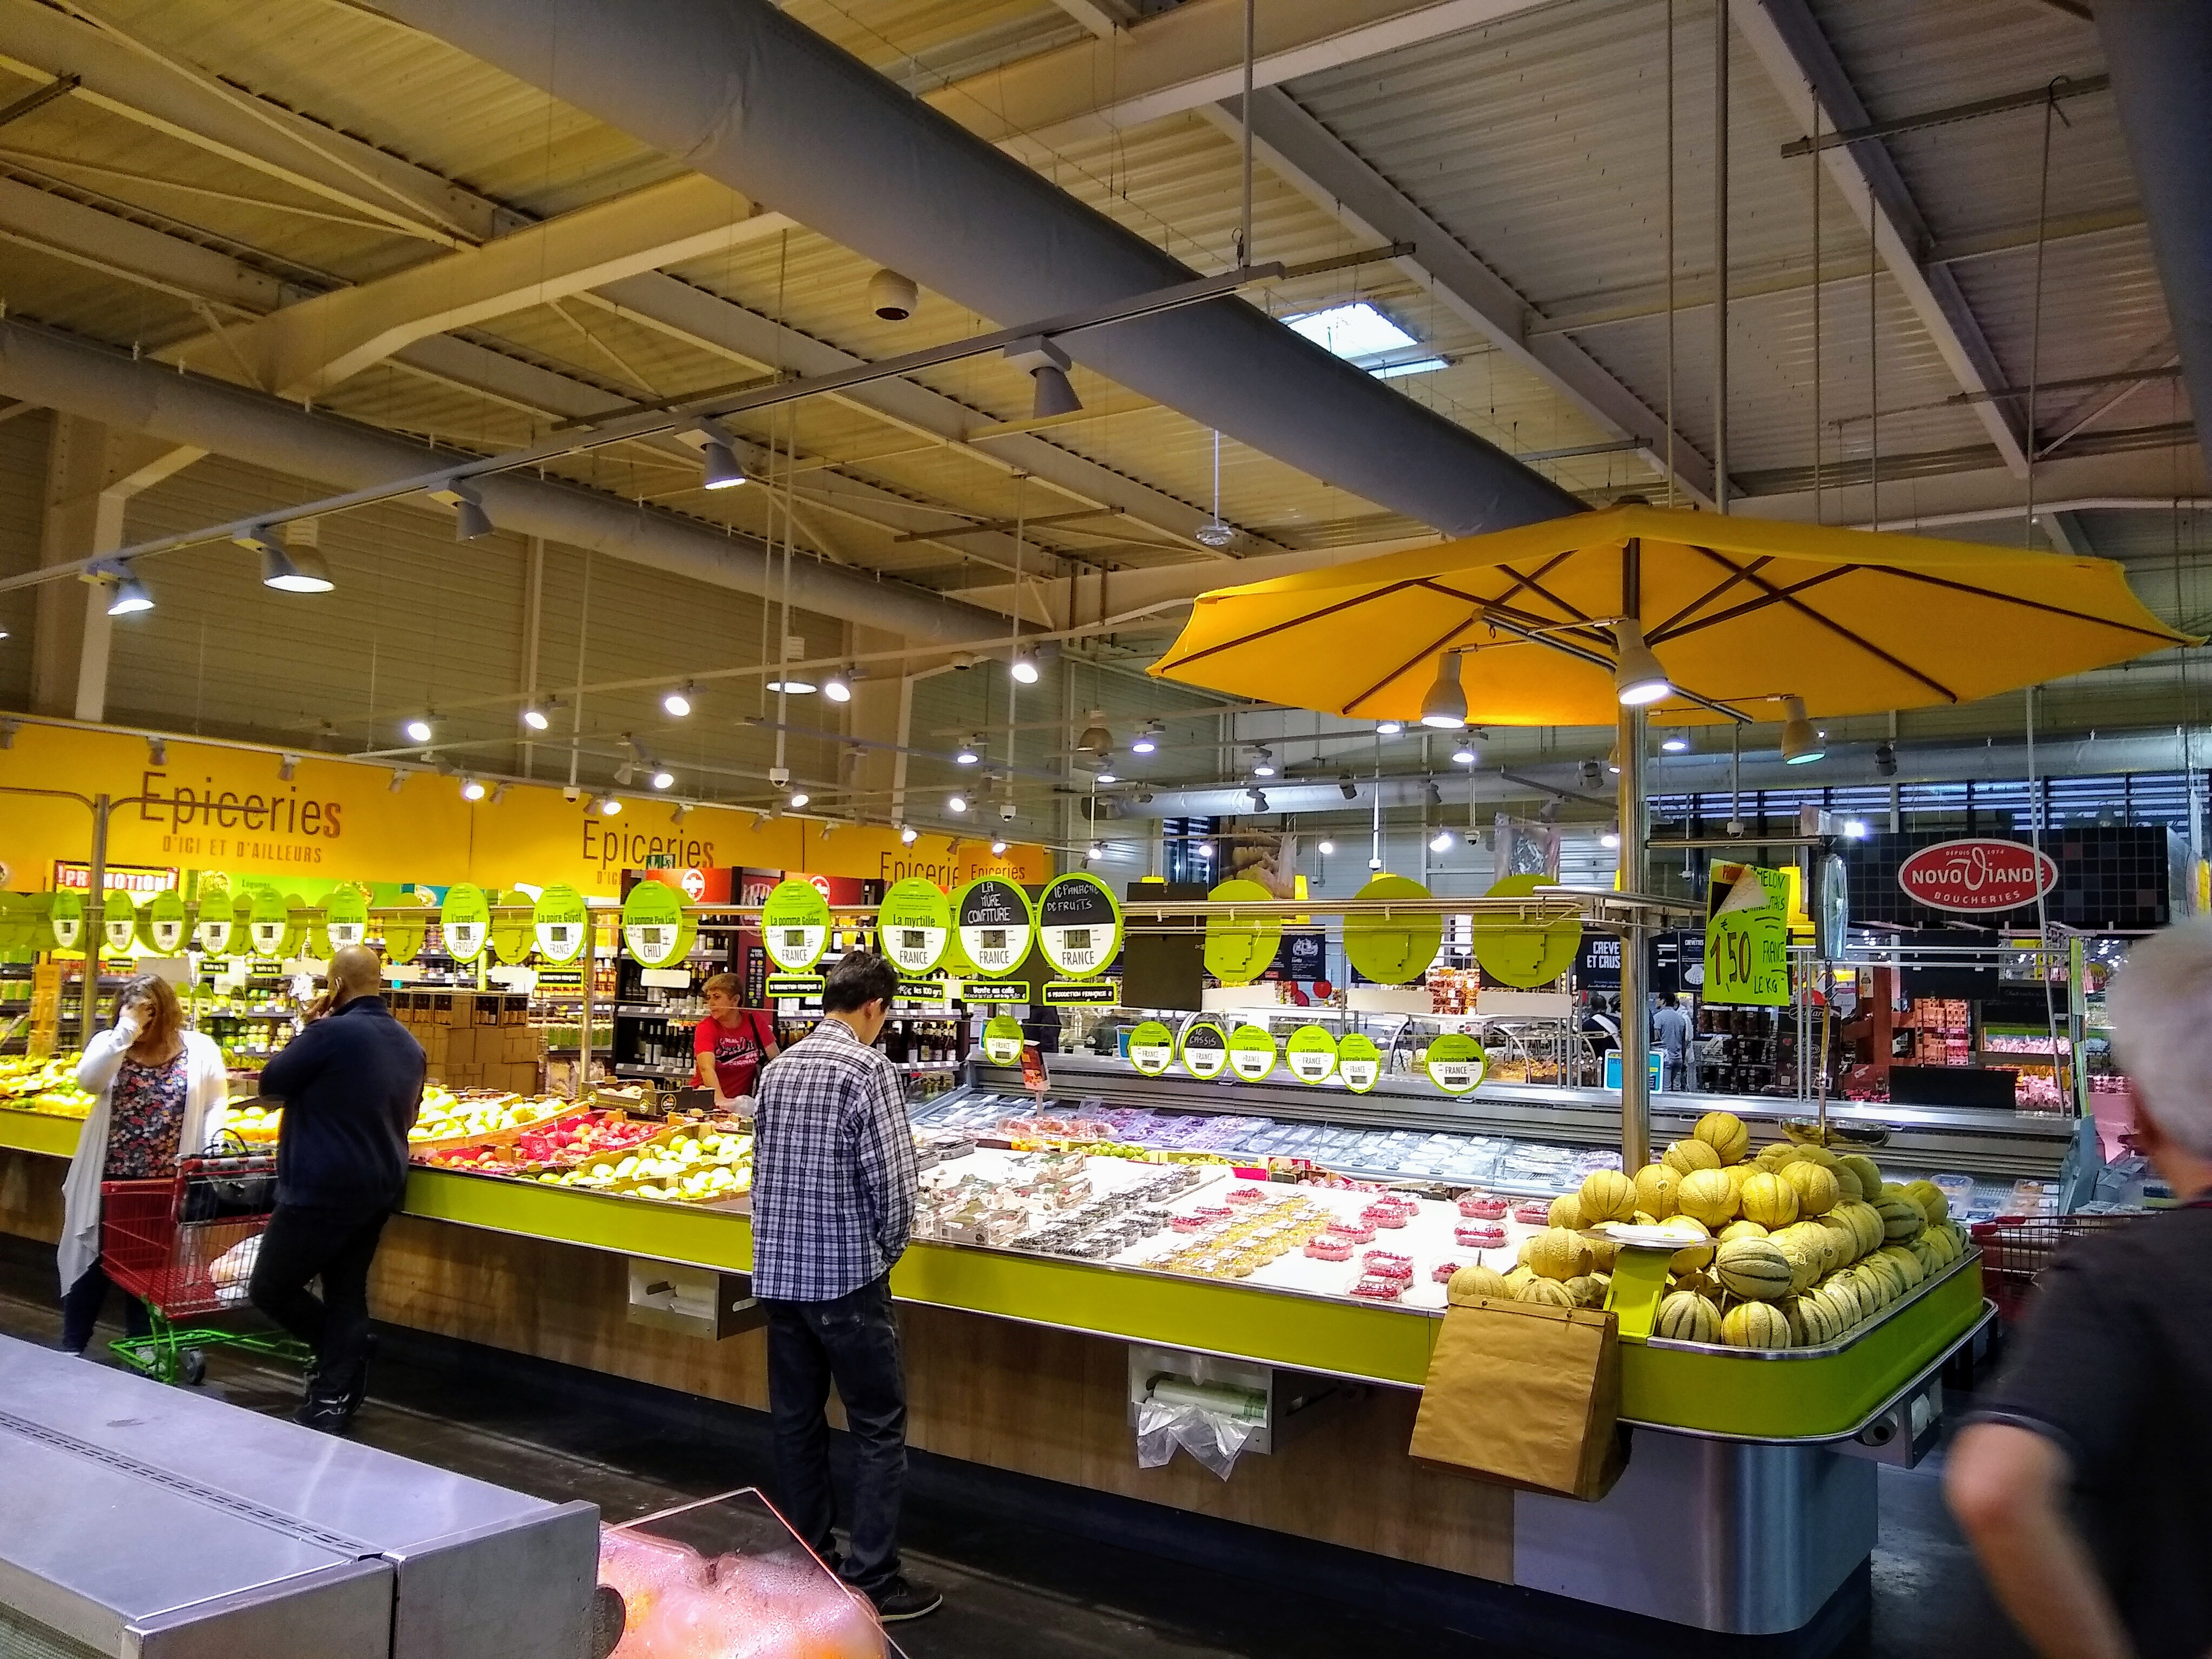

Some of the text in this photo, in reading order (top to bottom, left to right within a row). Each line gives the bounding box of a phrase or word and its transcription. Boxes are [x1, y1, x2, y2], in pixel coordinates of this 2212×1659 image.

[140, 771, 341, 839] Epiceries
[583, 819, 714, 869] Epiceries
[210, 840, 227, 856] ET
[237, 841, 321, 863] D'AILLEURS
[981, 881, 994, 894] LA
[1934, 890, 2020, 905] BOUCHERIES
[1047, 898, 1092, 912] DE FRUITS
[538, 913, 583, 923] La poire Guyot
[627, 915, 634, 925] La
[635, 916, 654, 925] pomme
[770, 915, 820, 927] La pomme Golden
[893, 914, 936, 928] La myrtille
[967, 907, 1011, 925] CONFITURE
[453, 942, 475, 953] AFRIQUE
[550, 943, 570, 955] FRANCE
[644, 945, 661, 957] CHILI
[782, 949, 808, 961] FRANCE
[900, 950, 928, 965] FRANCE
[979, 950, 1010, 964] FRANCE
[1062, 951, 1095, 966] FRANCE
[1587, 955, 1596, 968] ET
[923, 986, 932, 994] 100
[1755, 975, 1777, 994] LE KG
[1082, 990, 1107, 999] FRANÇAISE
[1189, 1035, 1217, 1047] CASSIS
[1196, 1053, 1213, 1061] FRANCE
[1243, 1054, 1260, 1063] FRANCE
[1302, 1057, 1321, 1065] FRANCE
[1350, 1065, 1366, 1073] FRANCE
[1445, 1066, 1468, 1075] FRANCE
